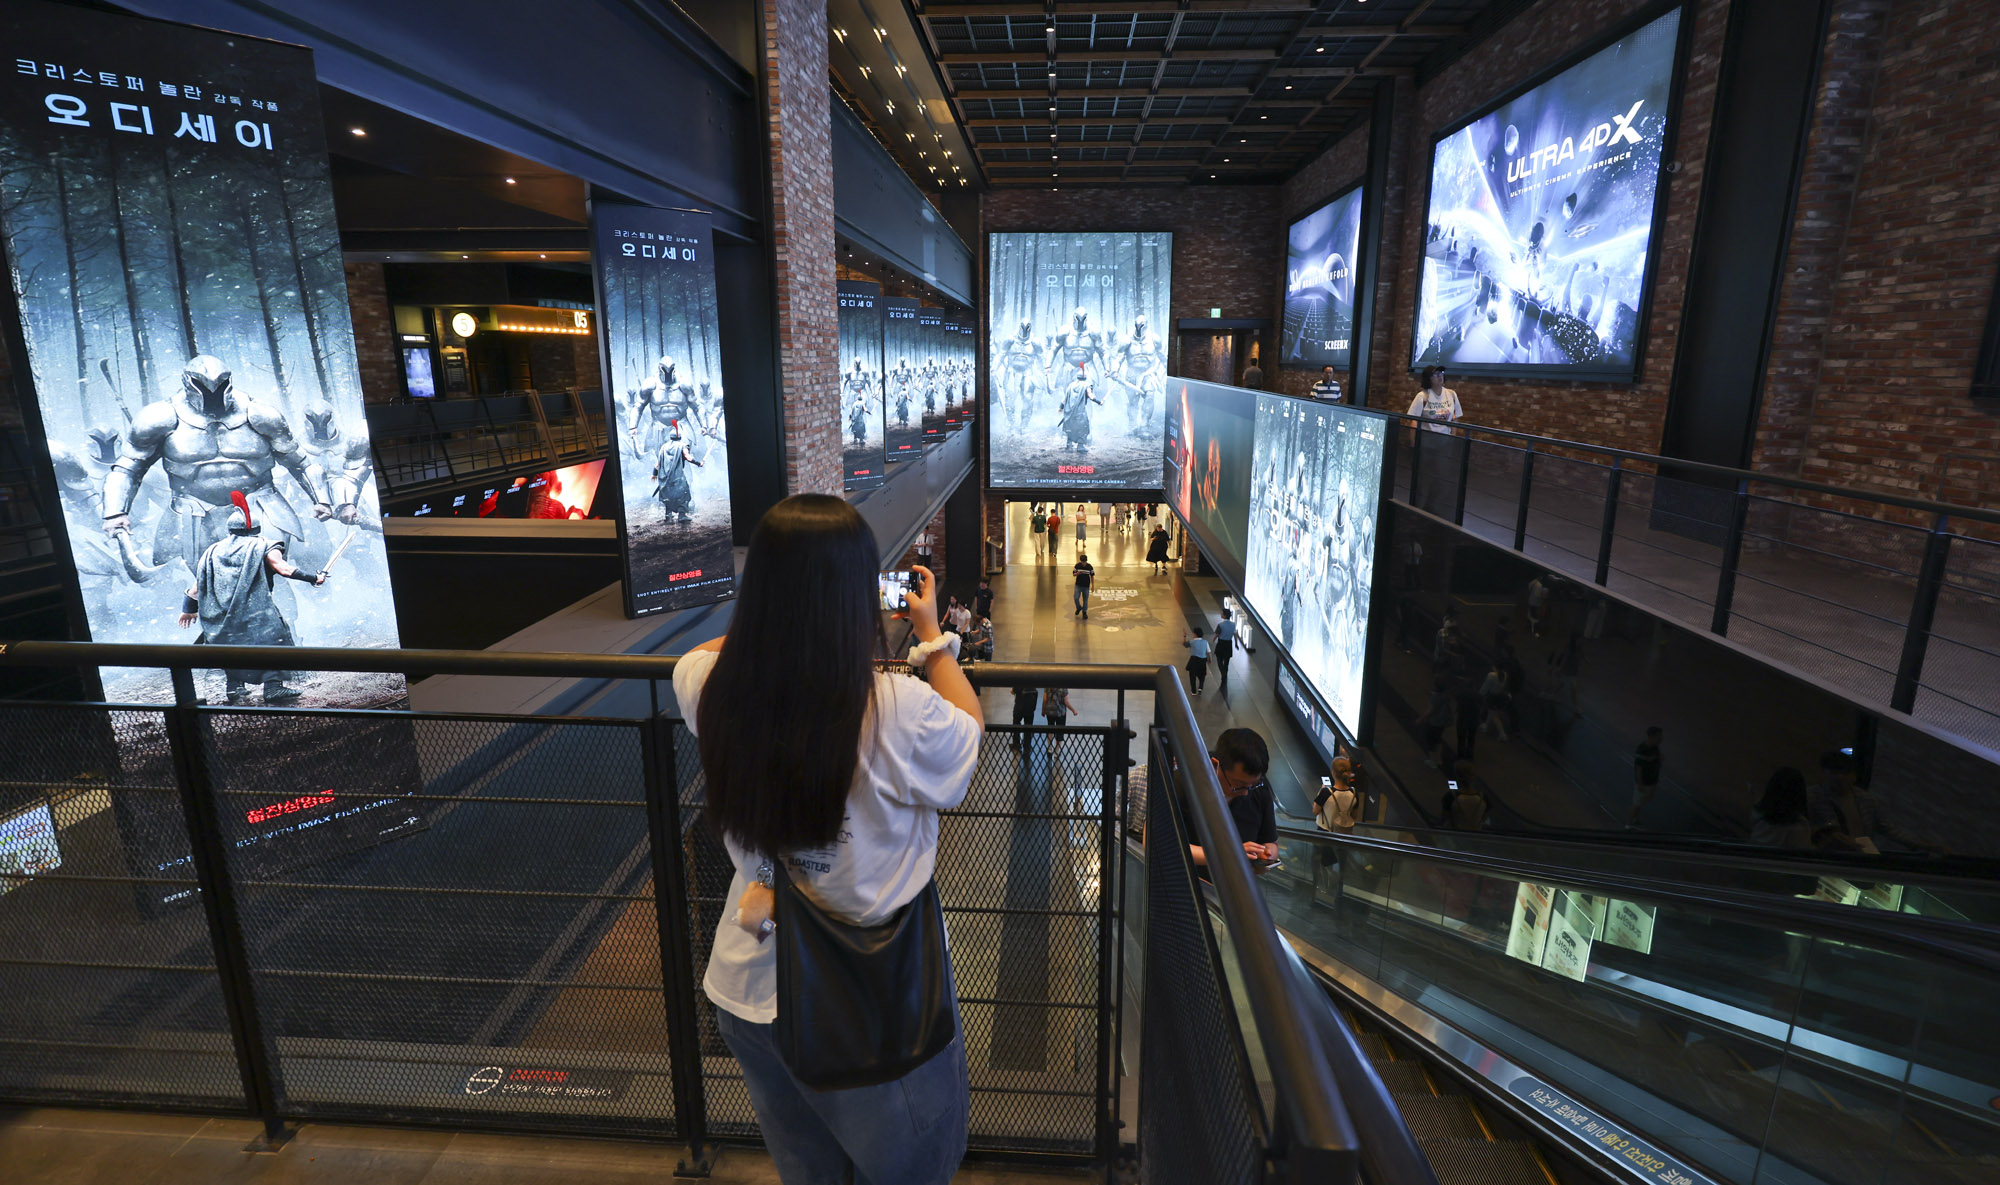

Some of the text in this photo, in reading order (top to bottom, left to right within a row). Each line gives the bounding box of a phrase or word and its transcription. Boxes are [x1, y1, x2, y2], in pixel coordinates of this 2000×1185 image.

[16, 58, 279, 113] 크리스토퍼 놀란 감독 작품
[44, 93, 273, 151] 오디세이
[1507, 99, 1645, 183] ULTRA 4DX
[1510, 151, 1632, 198] ULTIMATE CINEMA EXPERIENCE
[622, 242, 697, 262] 오디세이
[840, 299, 873, 308] 오디세이
[460, 317, 469, 333] 5
[573, 311, 588, 329] 05
[298, 815, 331, 830] IMAX
[1528, 1088, 1560, 1109] 주세요
[1553, 1104, 1589, 1126] 탑승해
[1622, 1147, 1665, 1173] 안전선
